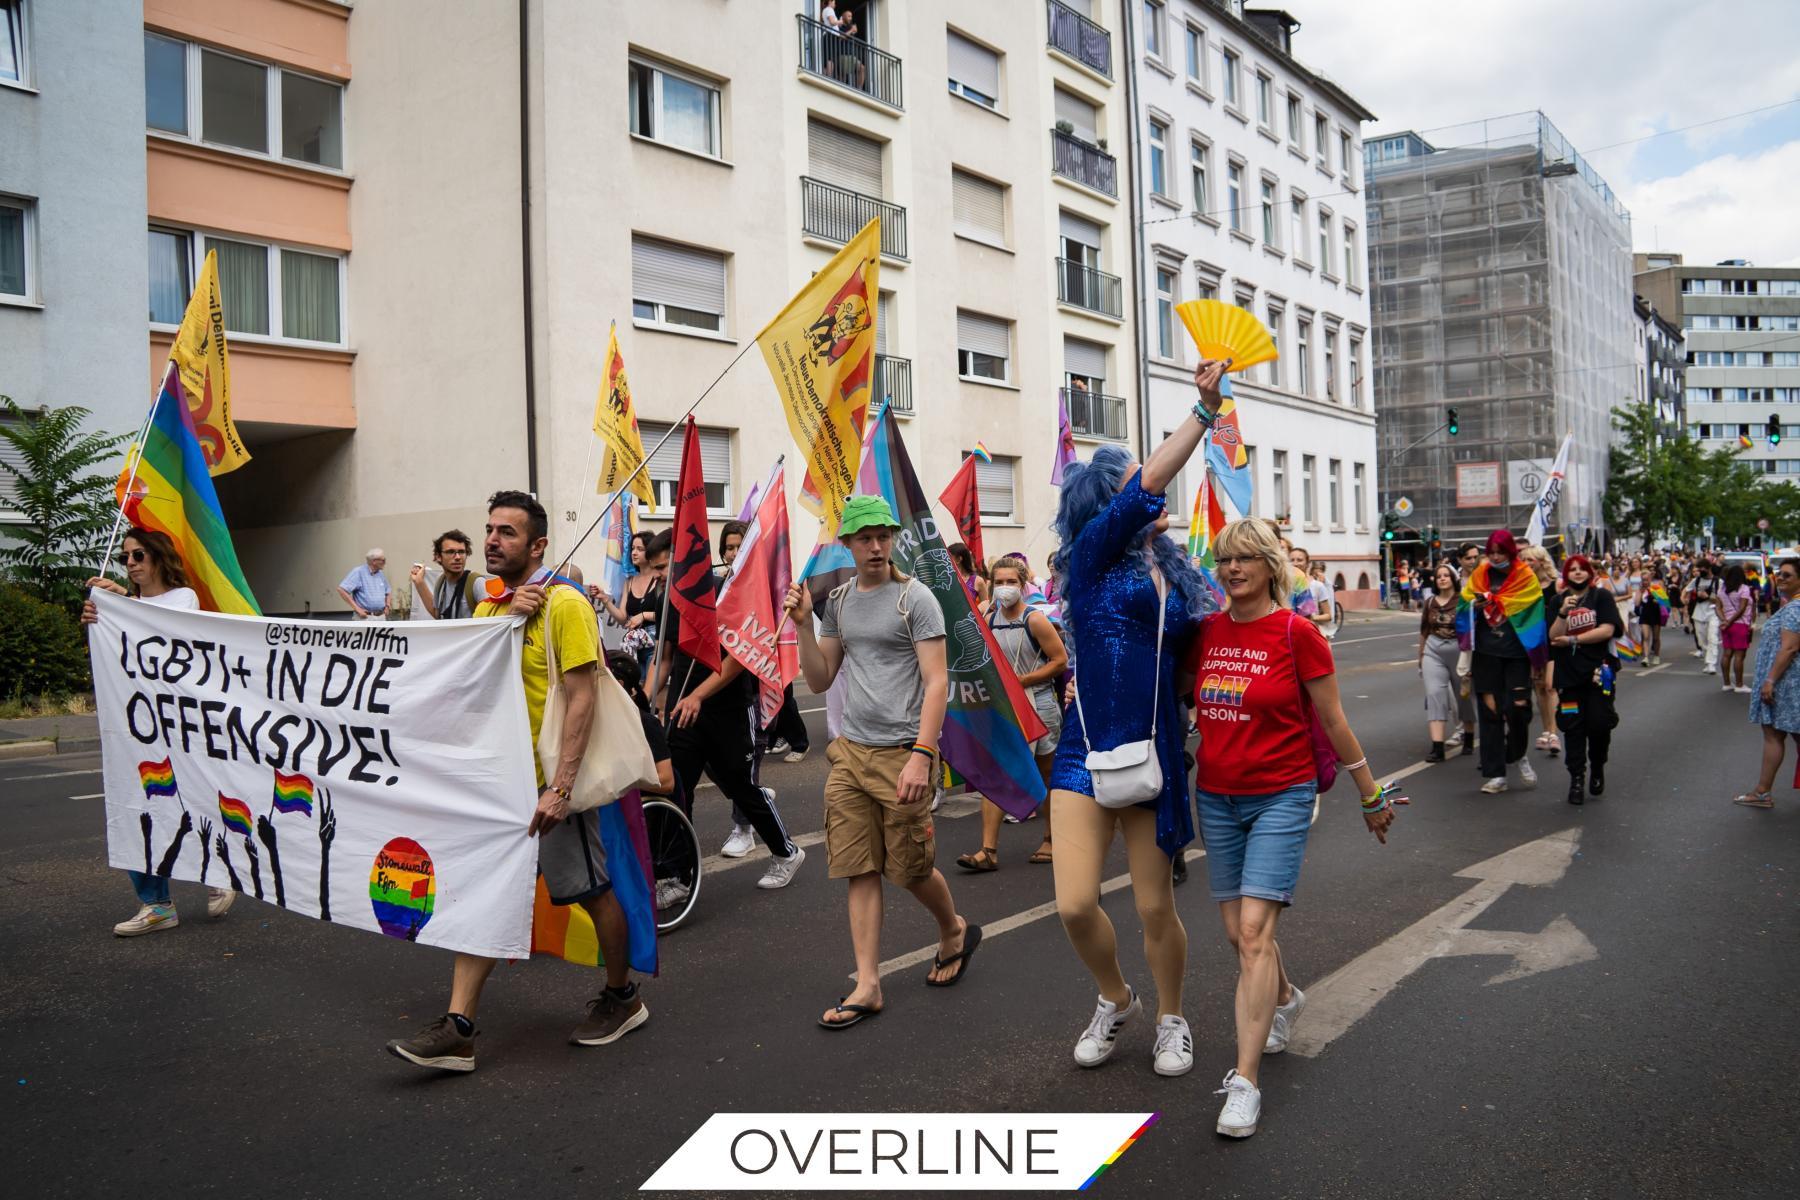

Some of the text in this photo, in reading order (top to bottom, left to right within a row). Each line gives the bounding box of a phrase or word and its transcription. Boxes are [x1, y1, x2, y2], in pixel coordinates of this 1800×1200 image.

[798, 353, 810, 382] Neue
[805, 377, 843, 458] Demokratische
[566, 511, 577, 522] 30
[265, 623, 409, 655] @stonewallffm
[1208, 647, 1268, 661] I LOVE AND
[120, 631, 405, 714] LGBTI+ IN DIE
[1202, 660, 1270, 676] SUPPORT MY
[1200, 673, 1252, 706] GAY
[126, 690, 401, 786] OFFENSIVE!
[377, 851, 431, 875] Stonewall
